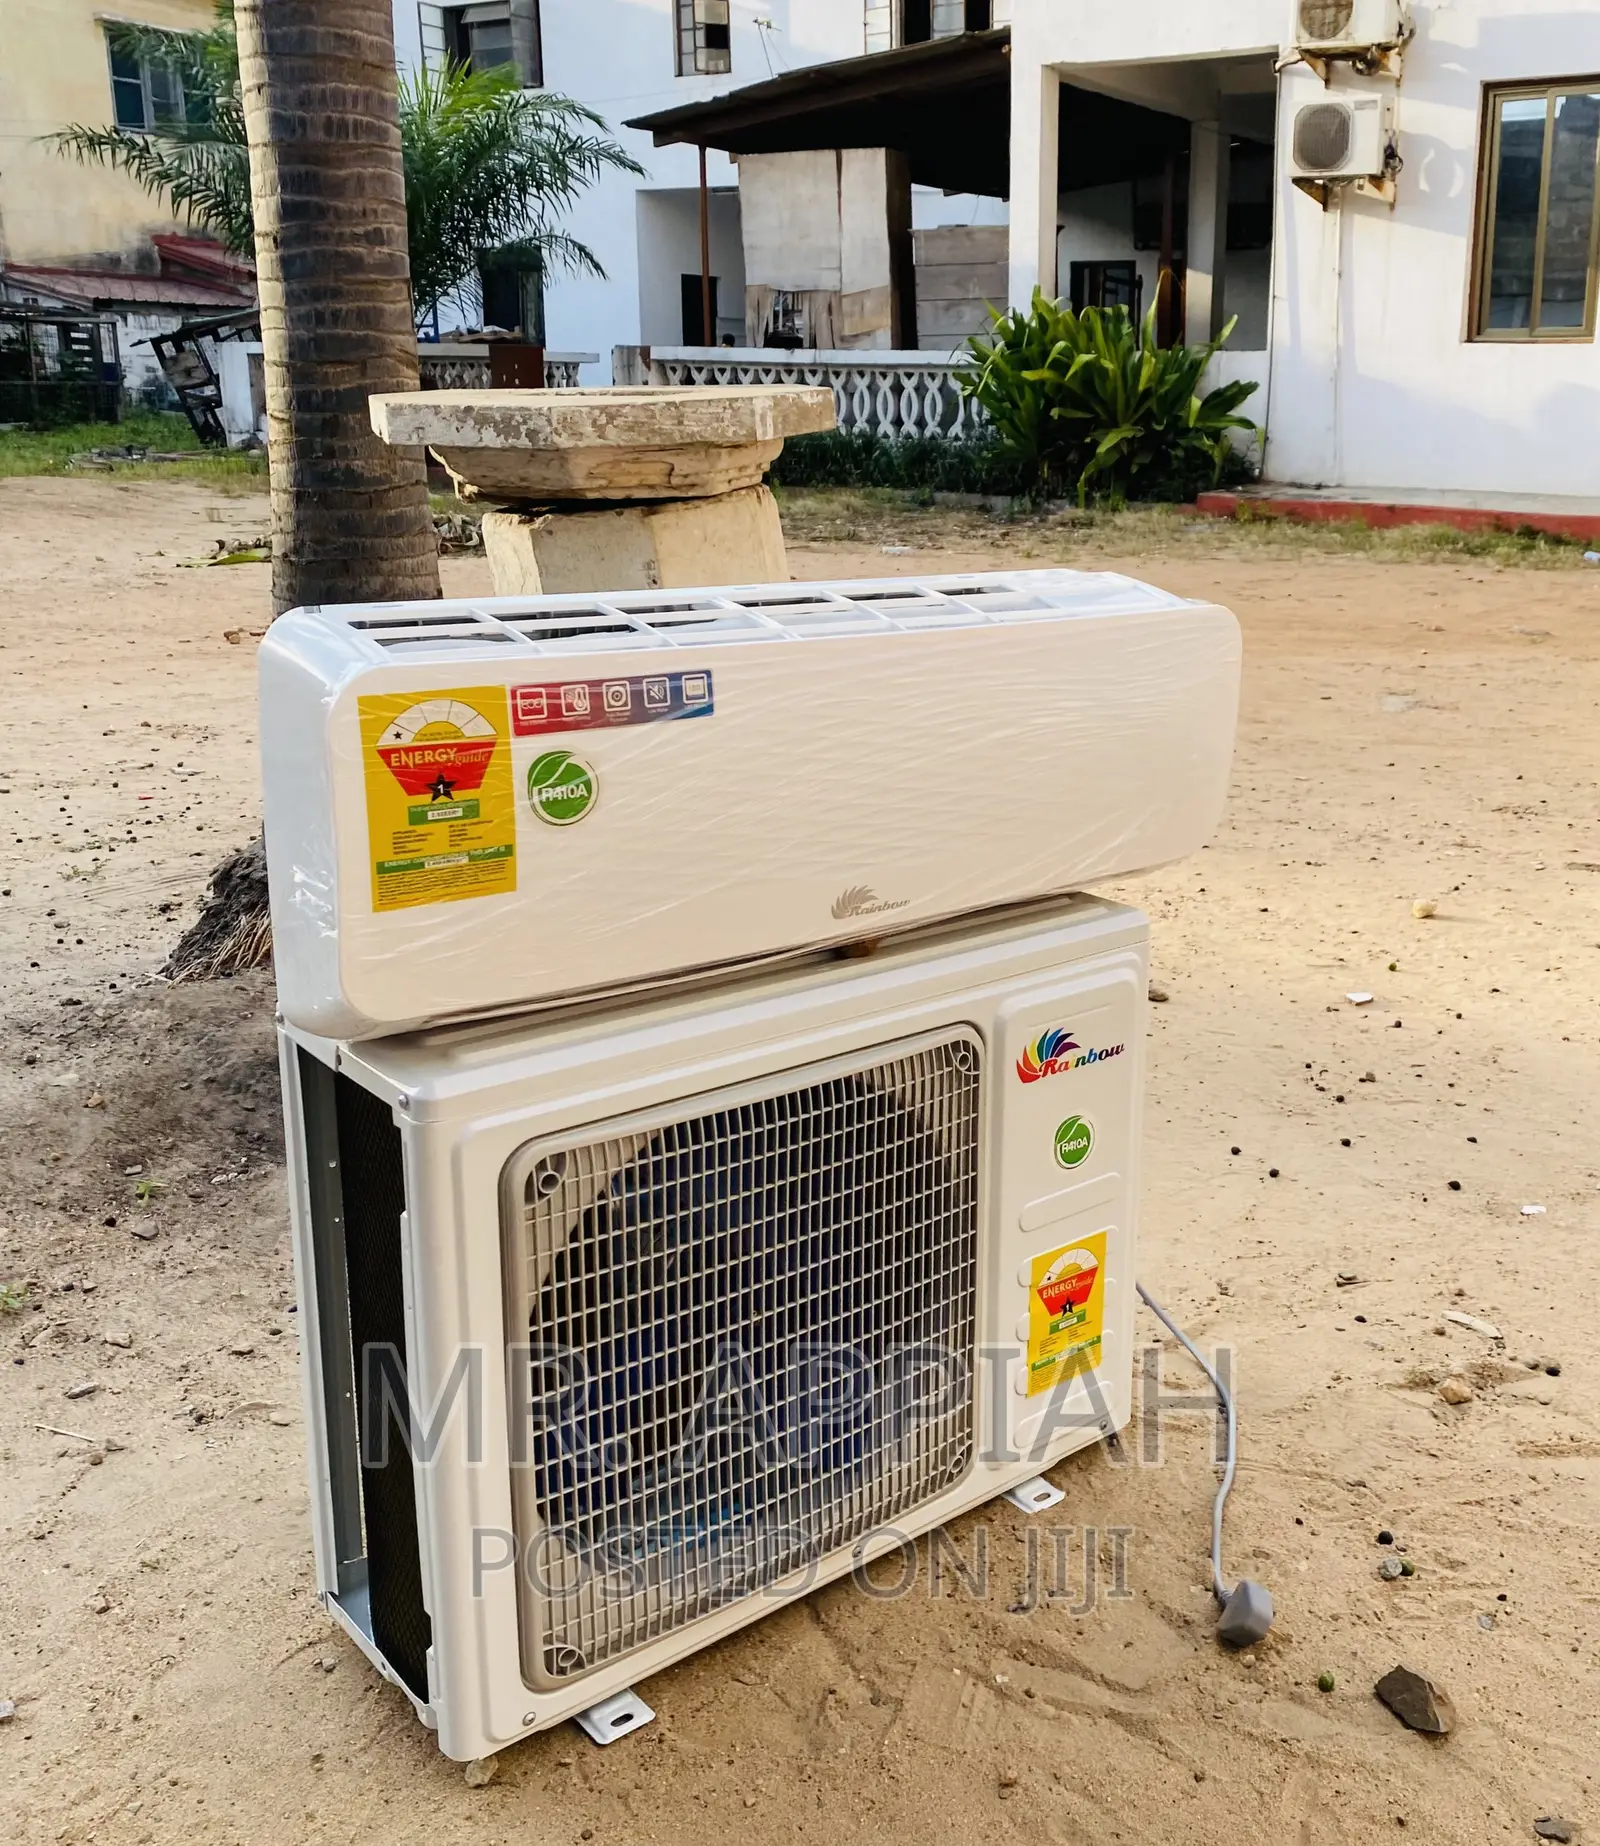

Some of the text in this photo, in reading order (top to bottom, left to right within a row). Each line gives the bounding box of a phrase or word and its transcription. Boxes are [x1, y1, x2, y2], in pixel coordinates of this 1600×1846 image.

[390, 748, 489, 769] ENERGY guide
[437, 784, 444, 794] 1
[541, 783, 589, 802] R410A
[848, 899, 911, 917] Rainbow
[1039, 1043, 1126, 1078] Rainbow
[1061, 1136, 1089, 1154] R410A
[1042, 1277, 1078, 1300] ENERGY
